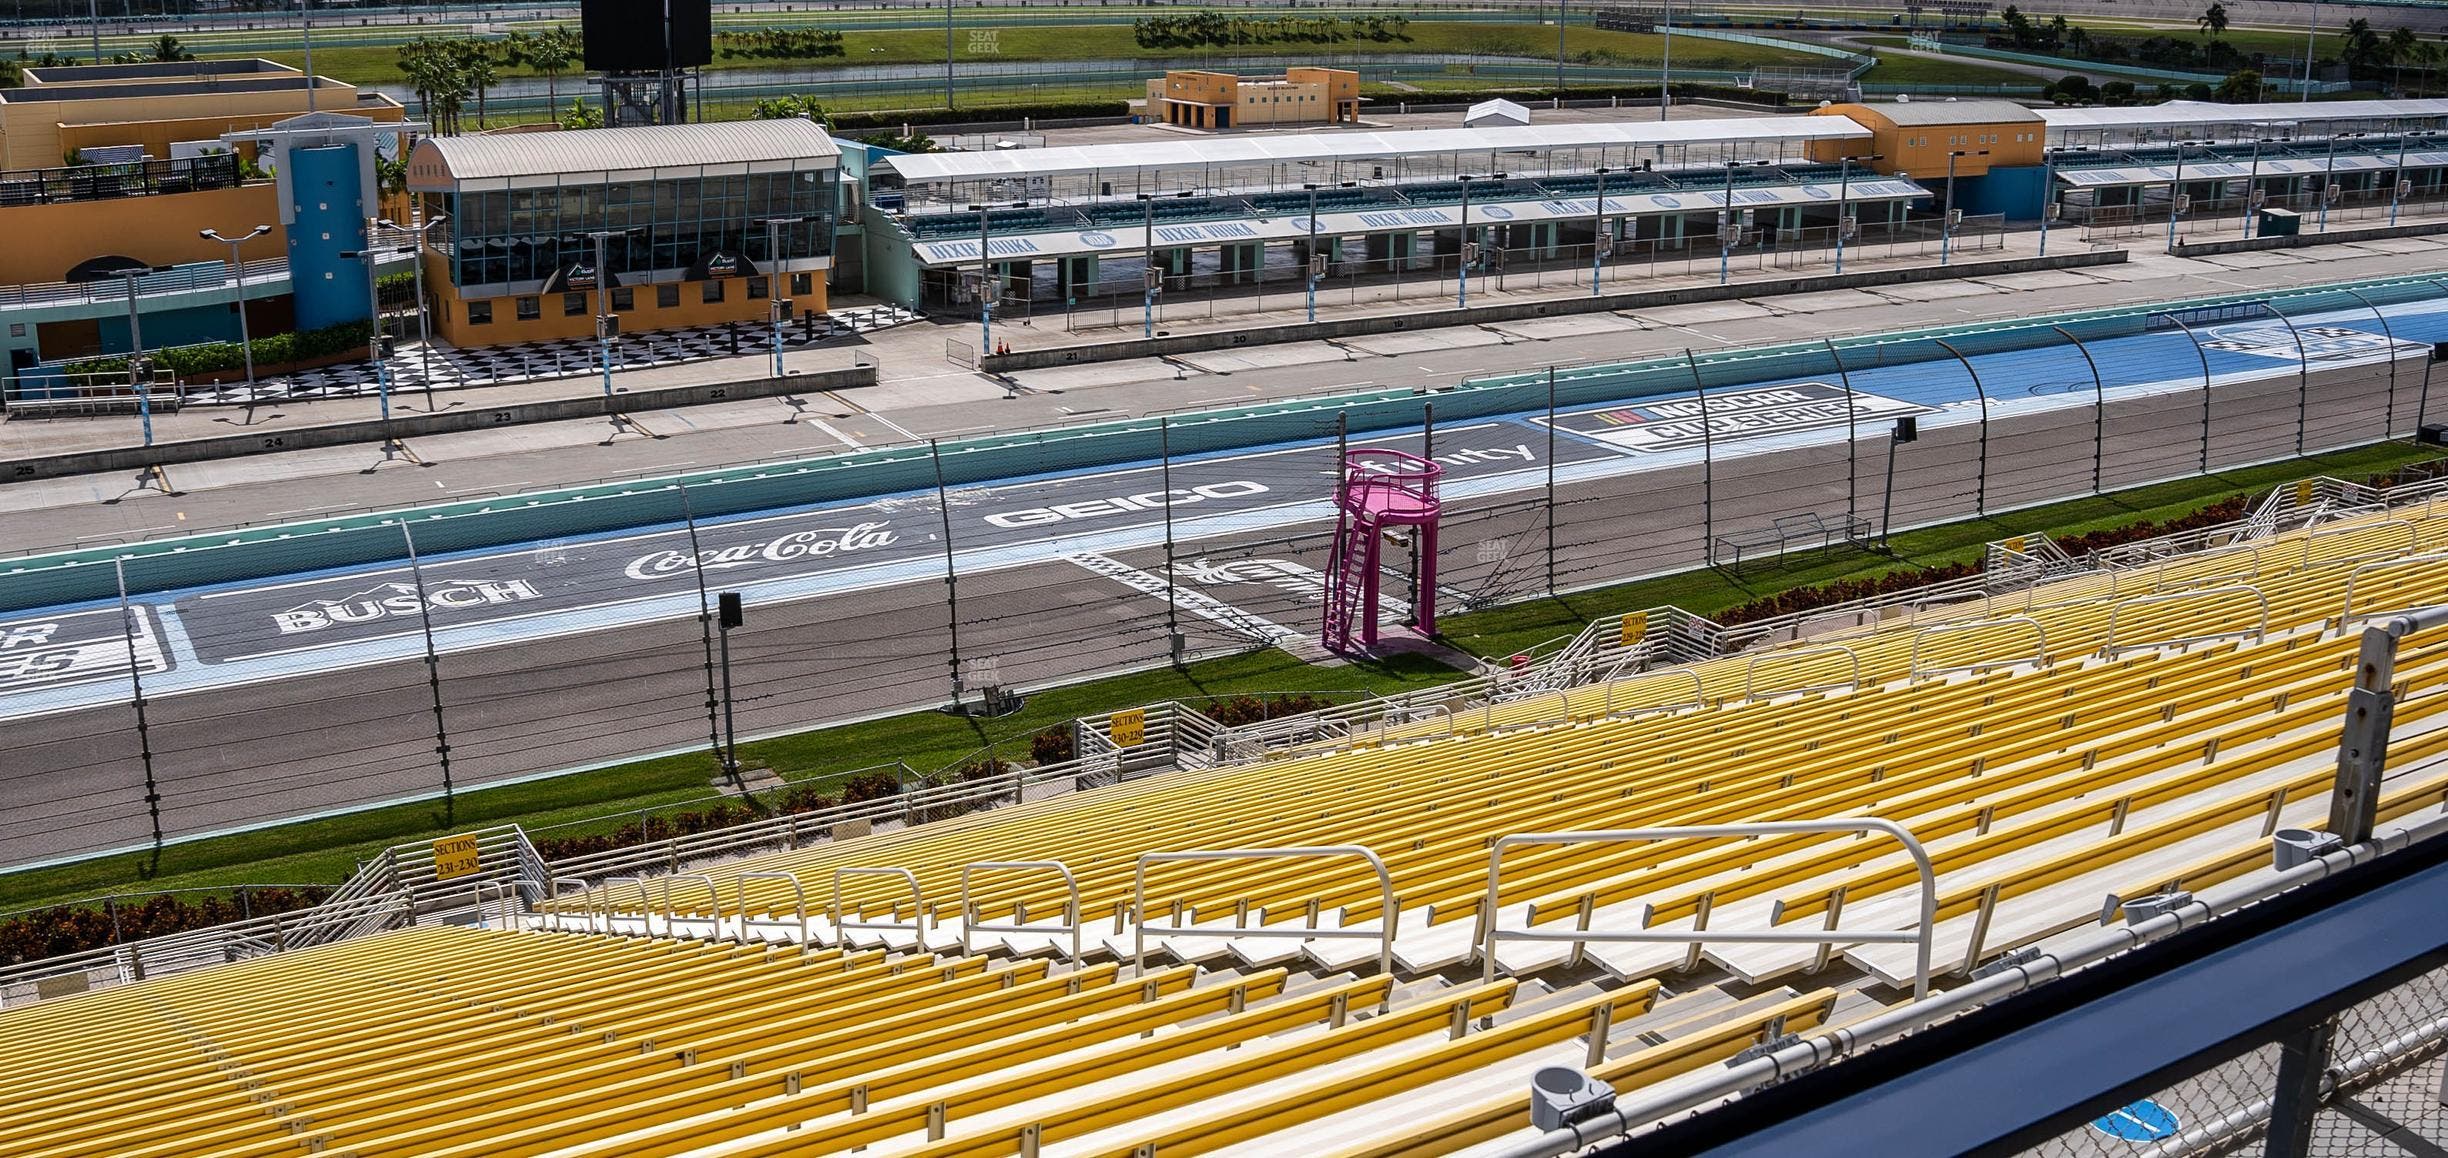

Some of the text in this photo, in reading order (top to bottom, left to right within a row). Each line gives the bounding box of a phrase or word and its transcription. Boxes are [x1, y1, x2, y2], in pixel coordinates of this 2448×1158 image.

[1155, 222, 1258, 242] DIXIE VODKA
[927, 237, 1040, 259] DIXIE VODKA
[1233, 335, 1247, 344] 20
[1065, 352, 1078, 361] 21
[710, 389, 726, 399] 22
[1646, 389, 1816, 419] NASCAR
[494, 412, 511, 423] 23
[1644, 399, 1873, 439] CUP SERIES
[264, 437, 284, 449] 24
[15, 465, 36, 476] 25
[983, 481, 1270, 528] GEICO
[624, 520, 900, 580] Coca-Cola
[271, 579, 543, 634] BUSCH
[1111, 713, 1143, 728] SECTIONS
[1111, 730, 1144, 744] 230-229
[435, 838, 476, 857] SECTIONS
[437, 857, 478, 875] 231-230
